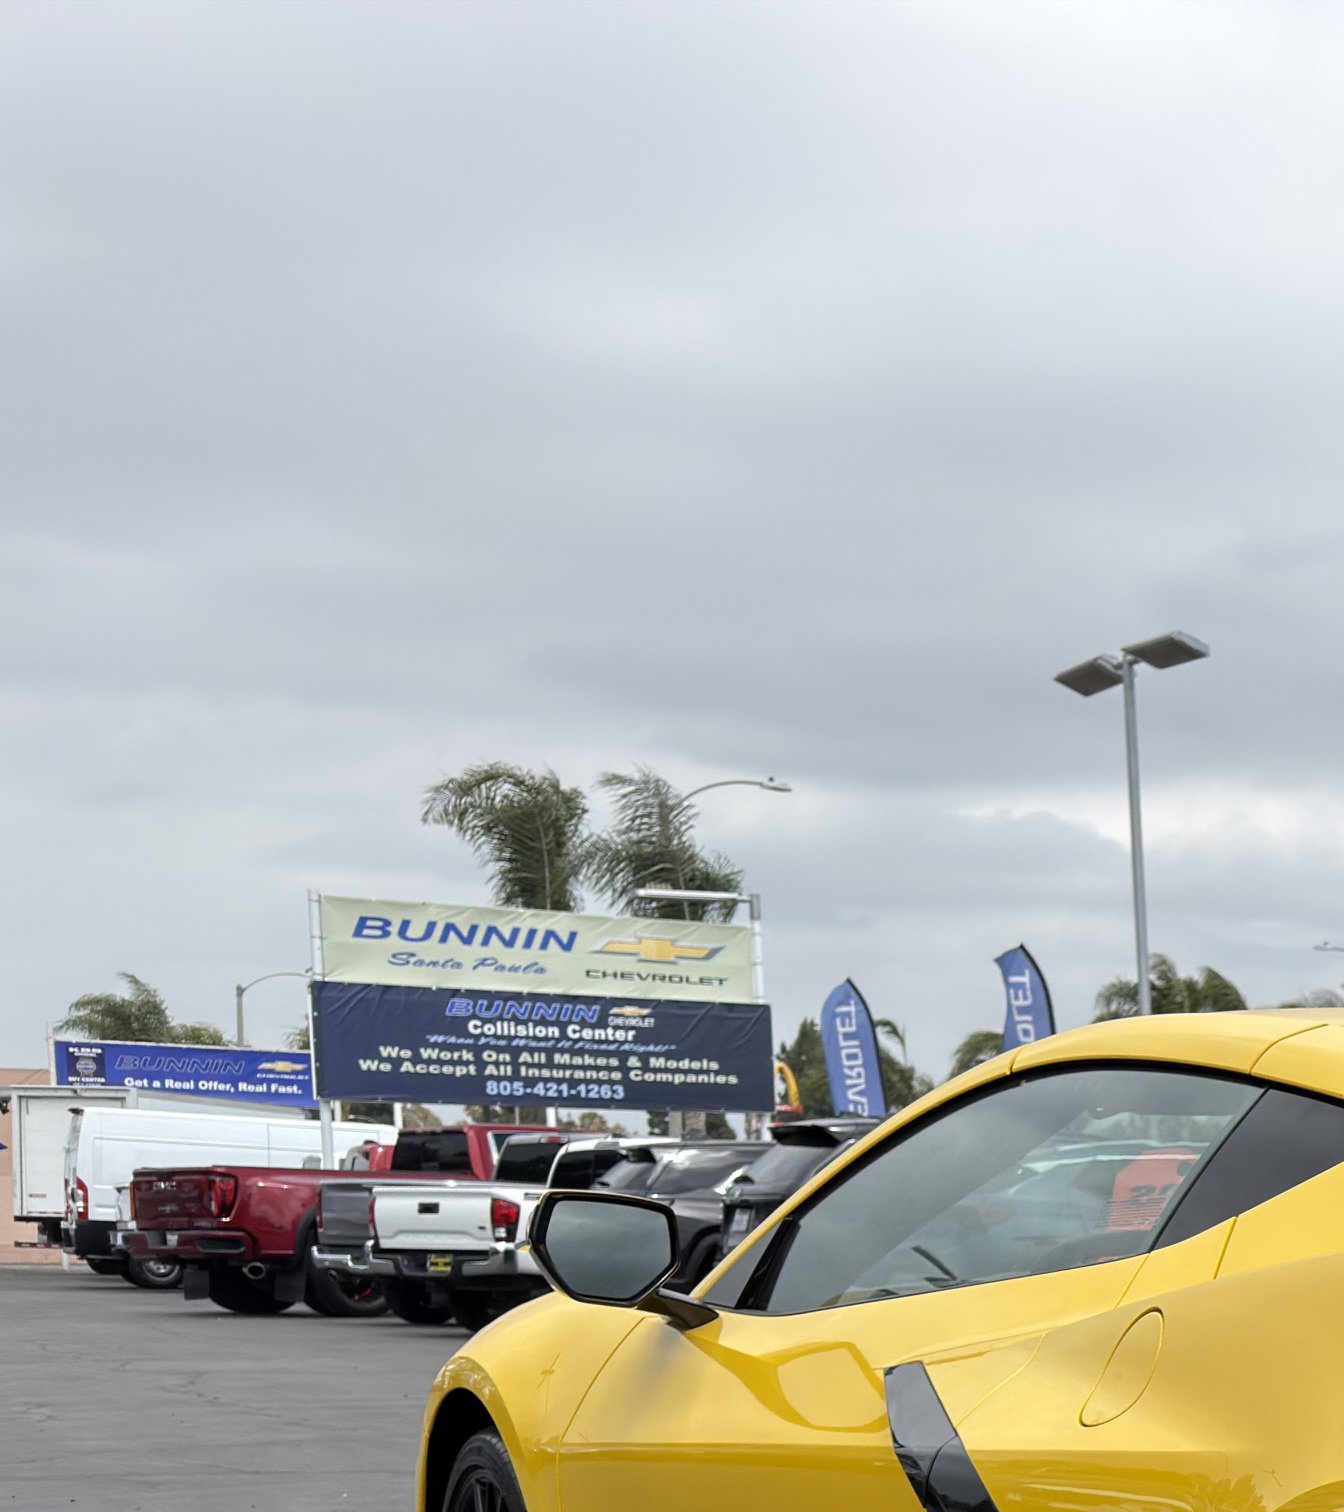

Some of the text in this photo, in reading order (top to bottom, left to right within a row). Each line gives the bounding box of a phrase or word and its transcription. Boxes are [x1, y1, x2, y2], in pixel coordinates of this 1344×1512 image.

[351, 915, 578, 952] BUNNIN
[388, 951, 546, 975] Santa Paula
[585, 969, 728, 986] CHEVROLET
[445, 997, 600, 1023] BUNNIN
[467, 1019, 637, 1041] Collision Center
[608, 1016, 654, 1027] CHEVROLET
[115, 1054, 245, 1074] BUNNIN
[379, 1045, 720, 1071] We Work On All Makes & Models
[358, 1058, 738, 1085] We Accept All Insurance Companies
[124, 1076, 303, 1095] Get a Real Offer, Real Fast.
[485, 1080, 625, 1099] 805-421-1263
